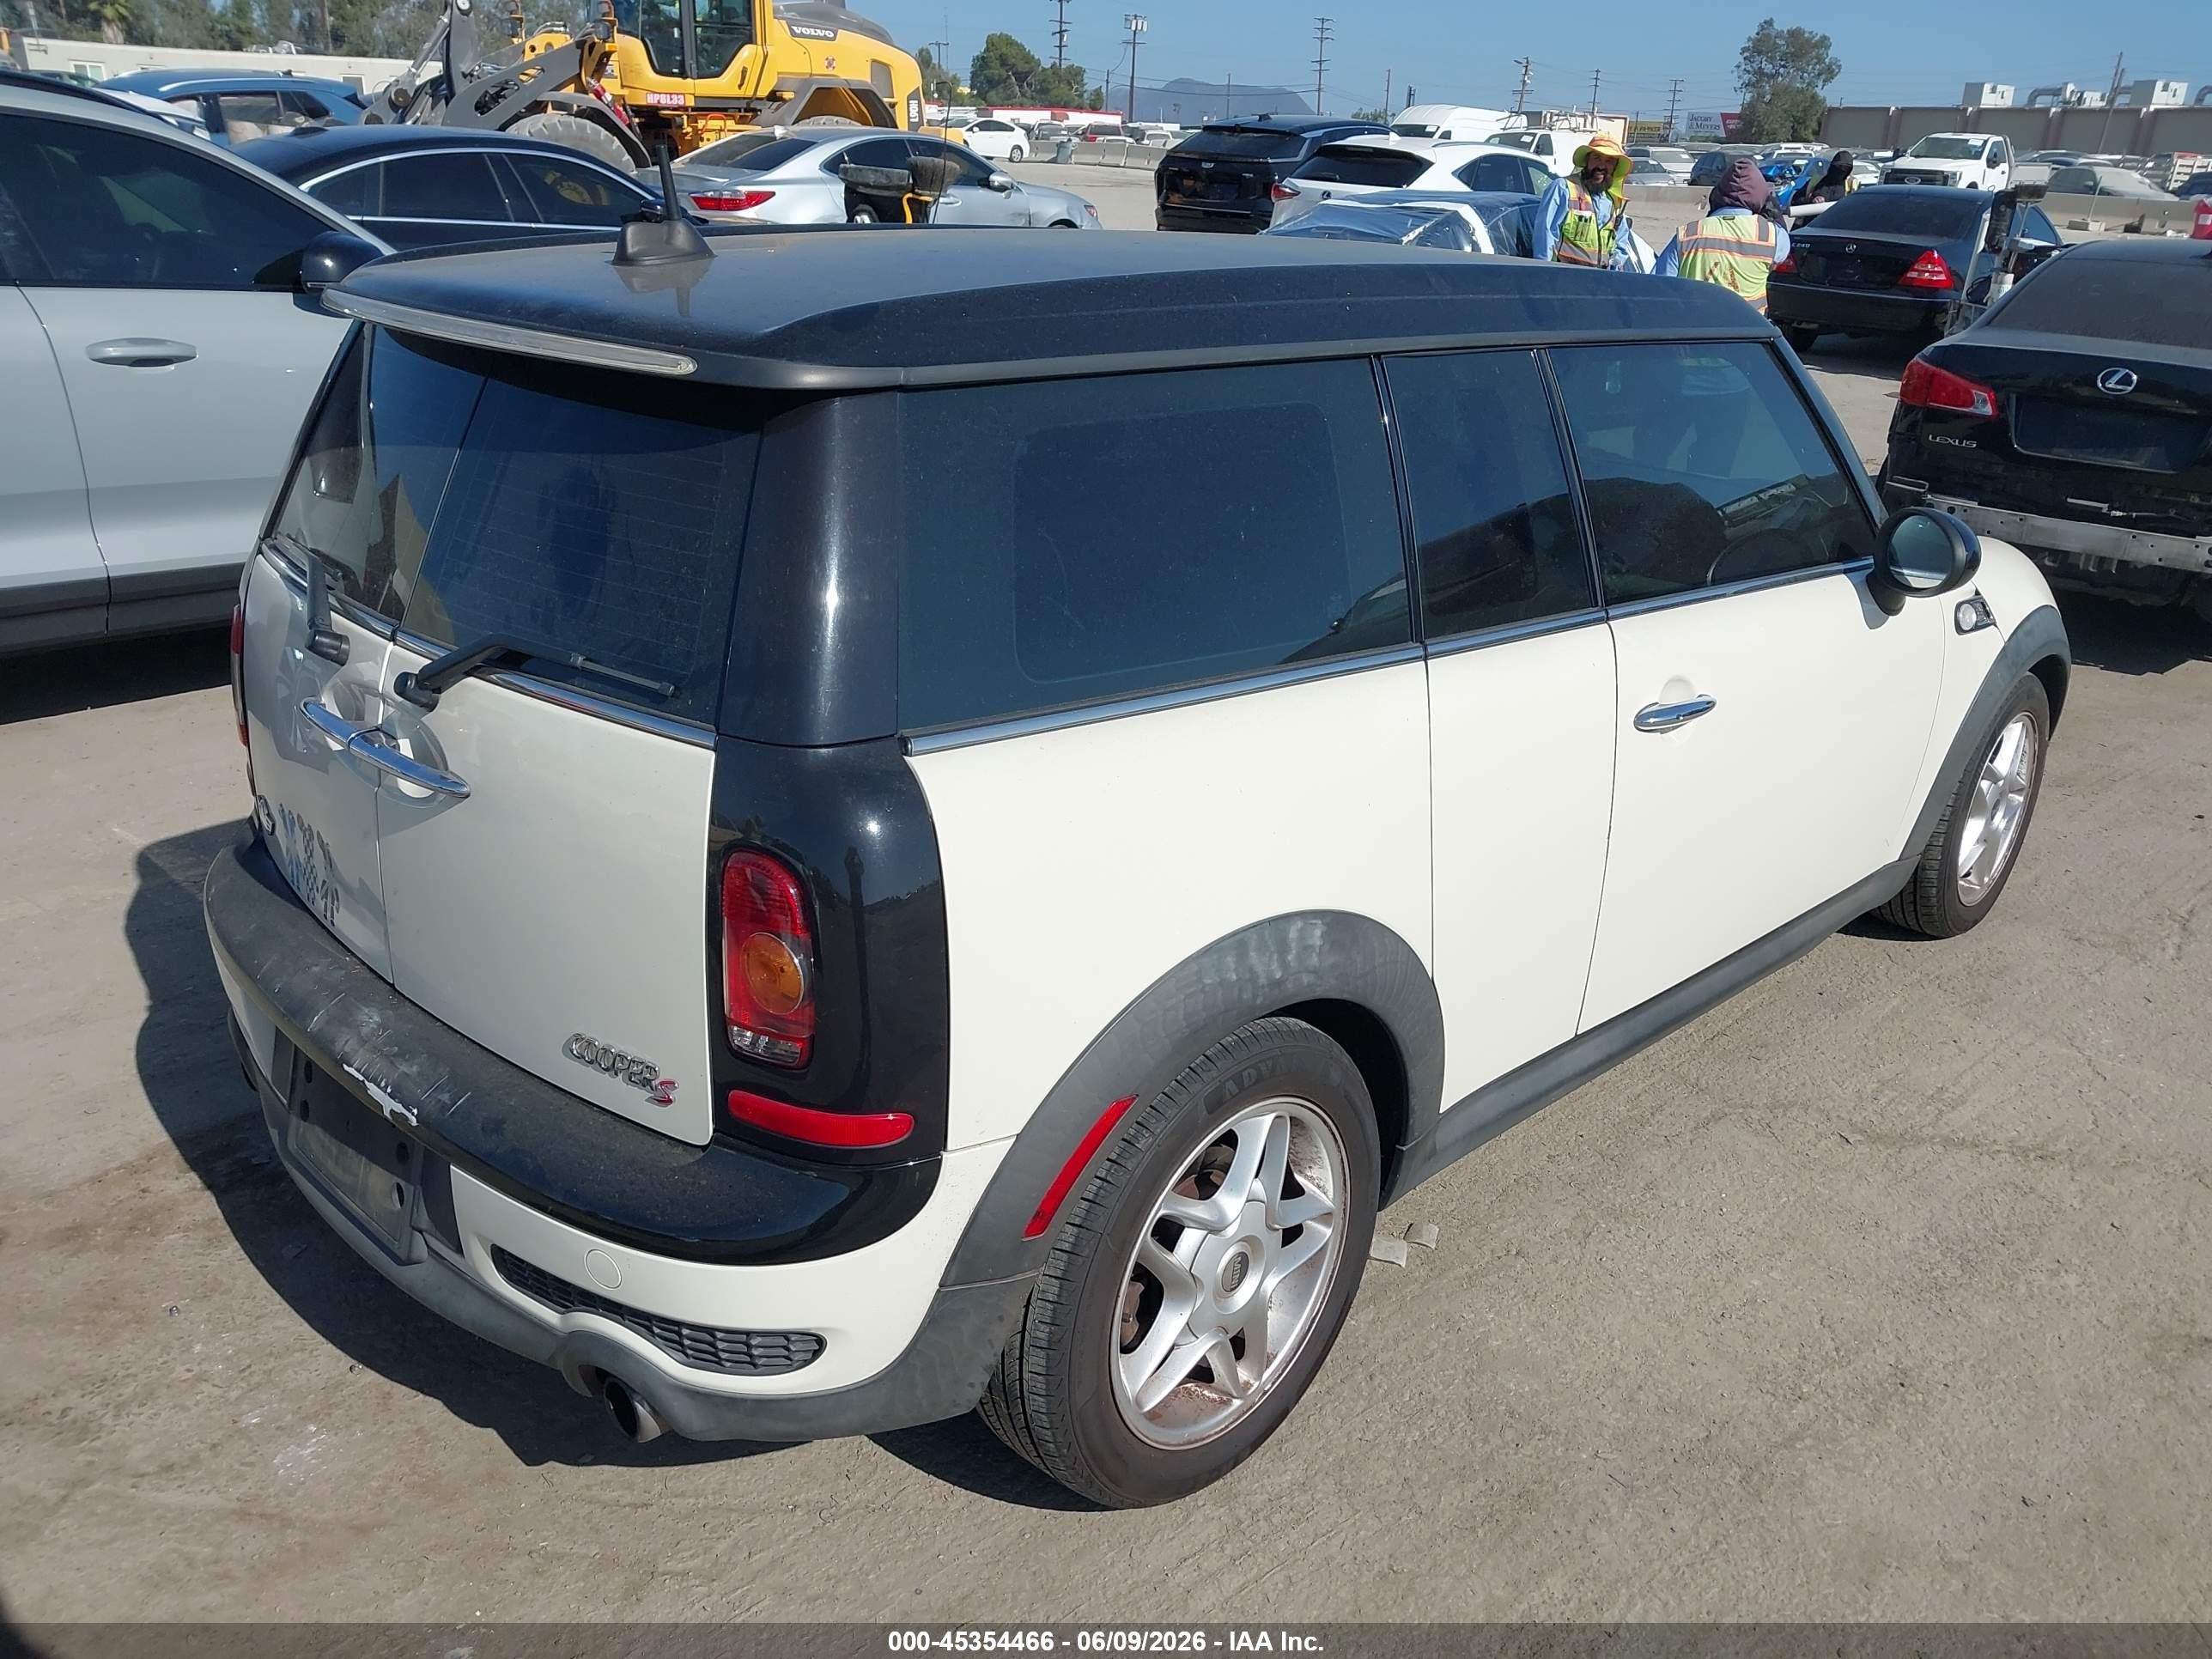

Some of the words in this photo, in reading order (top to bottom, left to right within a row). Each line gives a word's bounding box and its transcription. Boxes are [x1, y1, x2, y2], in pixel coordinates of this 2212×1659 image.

[791, 26, 835, 38] VOLVO
[908, 100, 919, 123] L90H
[1929, 434, 1978, 447] LEXUS
[562, 1033, 660, 1095] COOPER
[646, 1079, 679, 1108] S
